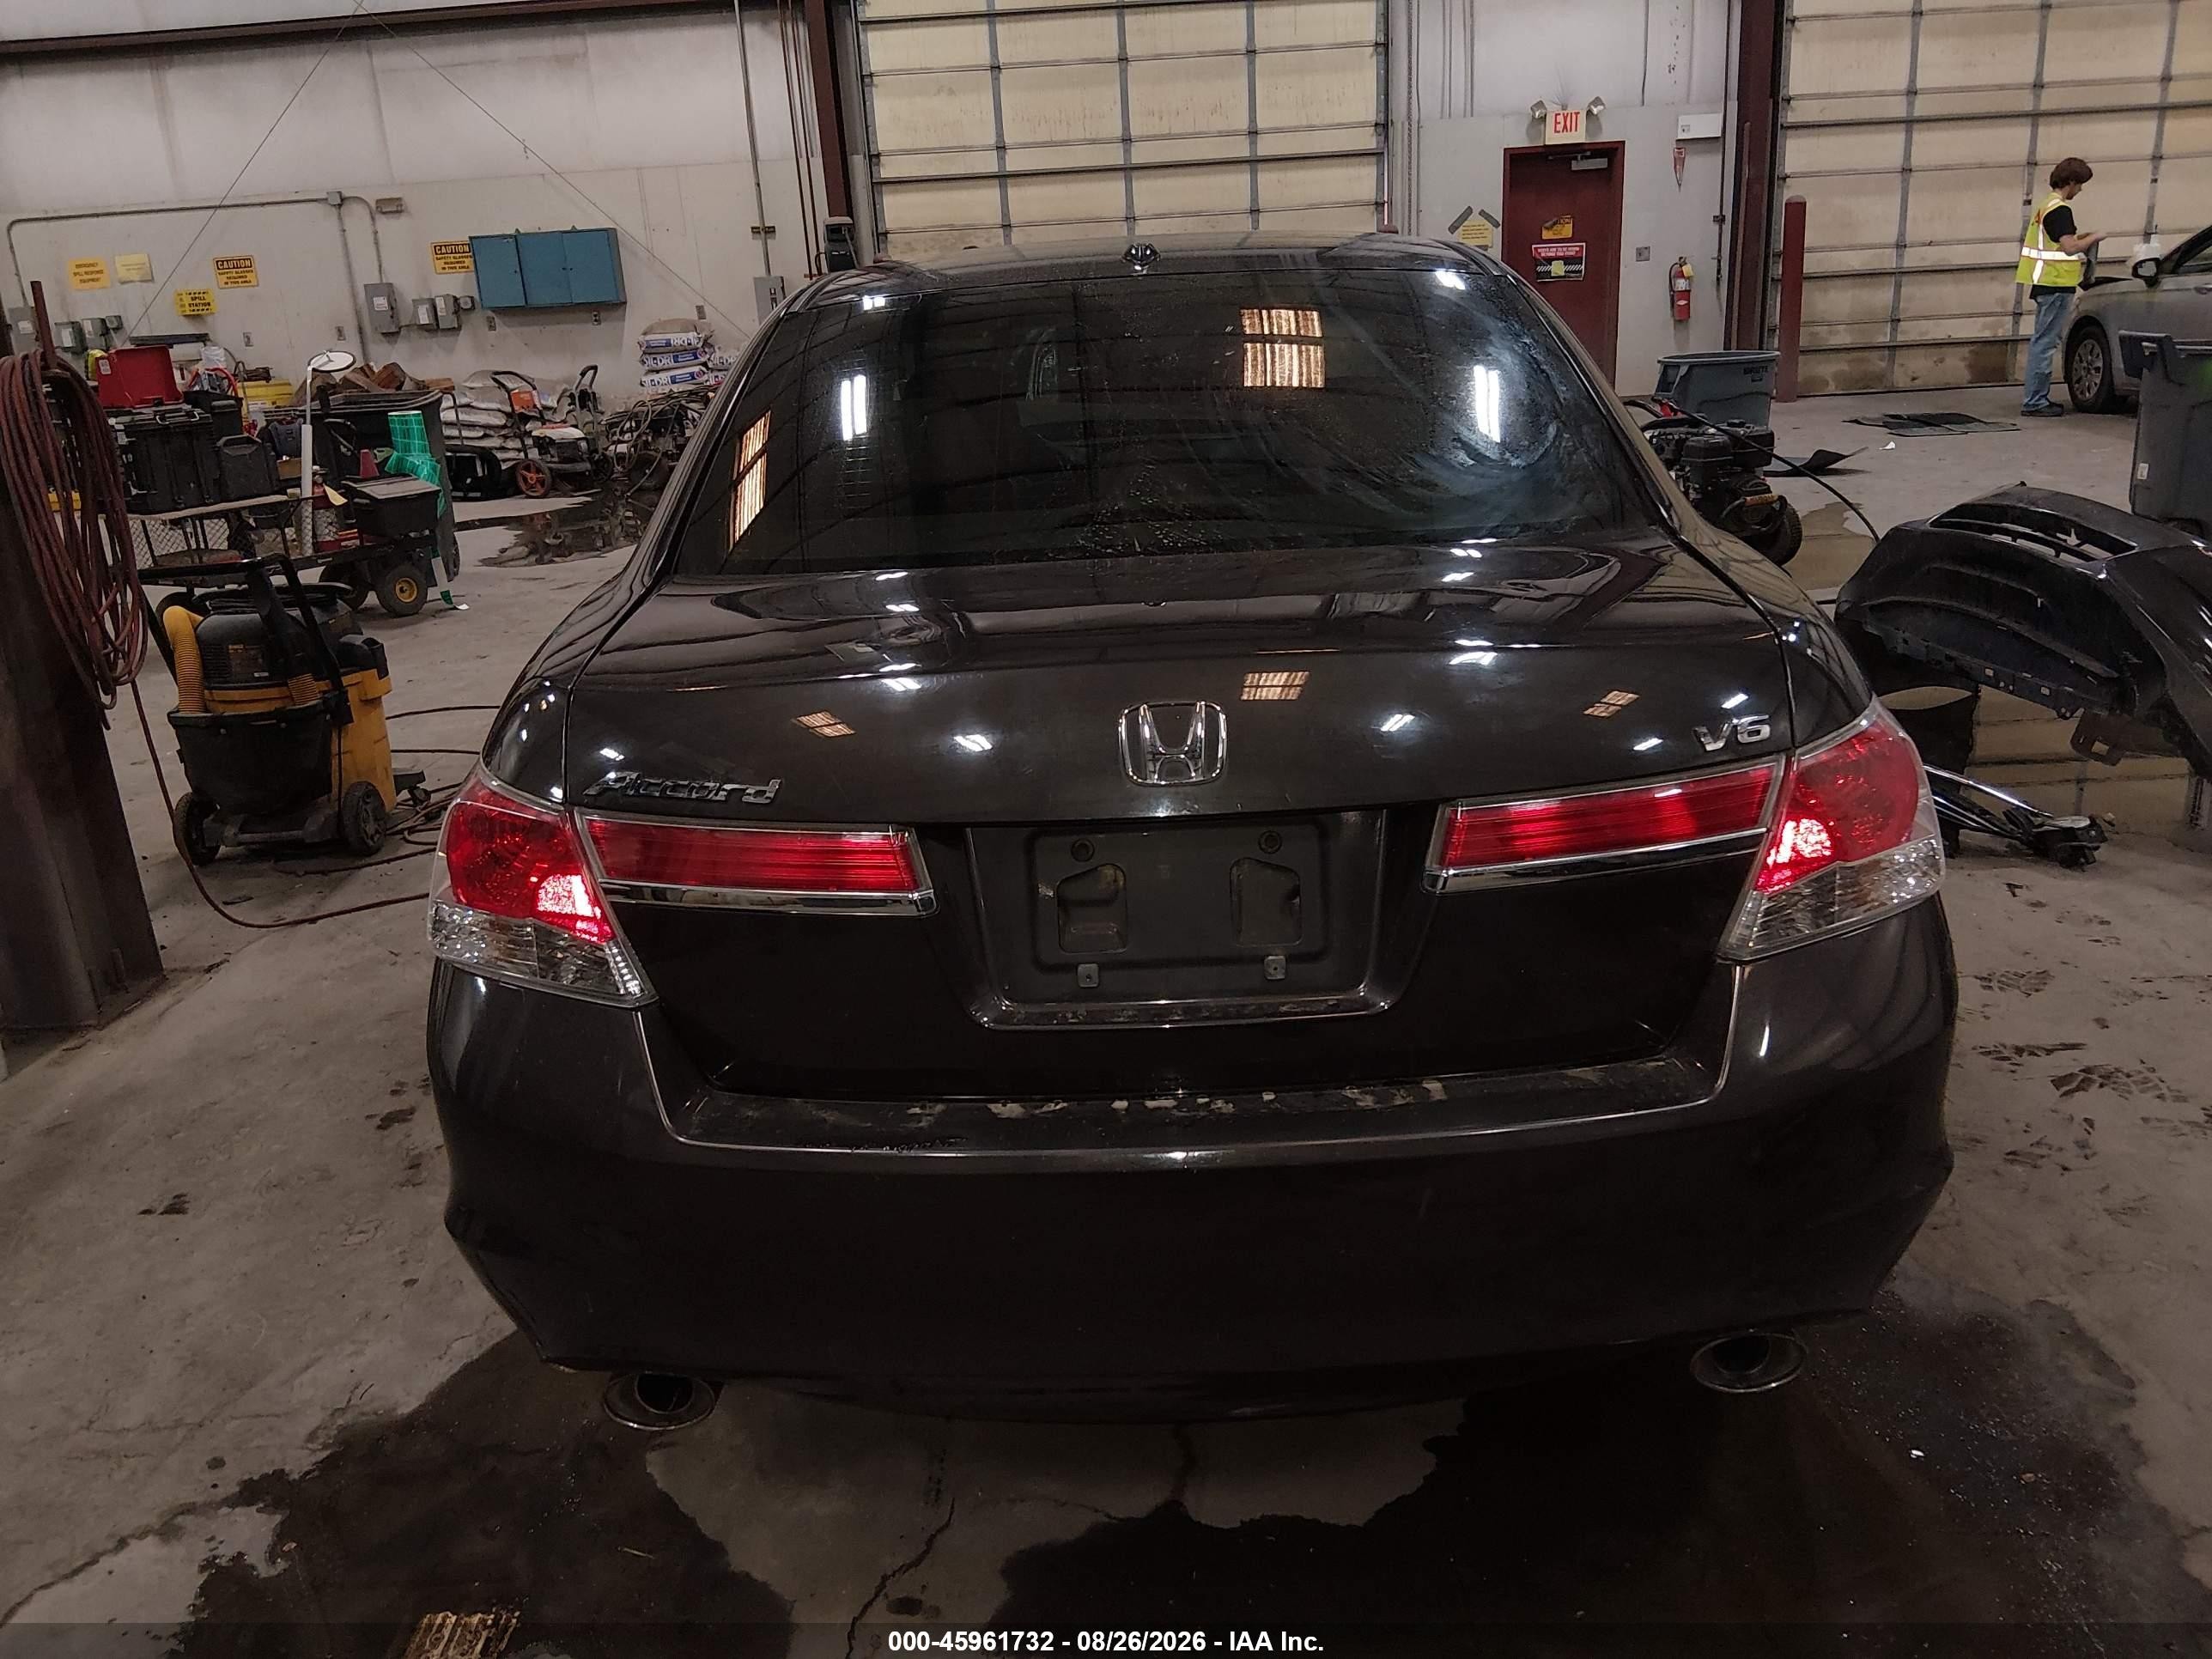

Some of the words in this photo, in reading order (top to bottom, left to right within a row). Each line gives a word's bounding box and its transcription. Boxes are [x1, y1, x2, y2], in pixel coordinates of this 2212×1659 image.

[1554, 112, 1580, 133] EXIT
[435, 245, 470, 254] CAUTION
[217, 259, 252, 269] CAUTION
[1692, 714, 1771, 751] V6
[583, 771, 781, 805] Accord
